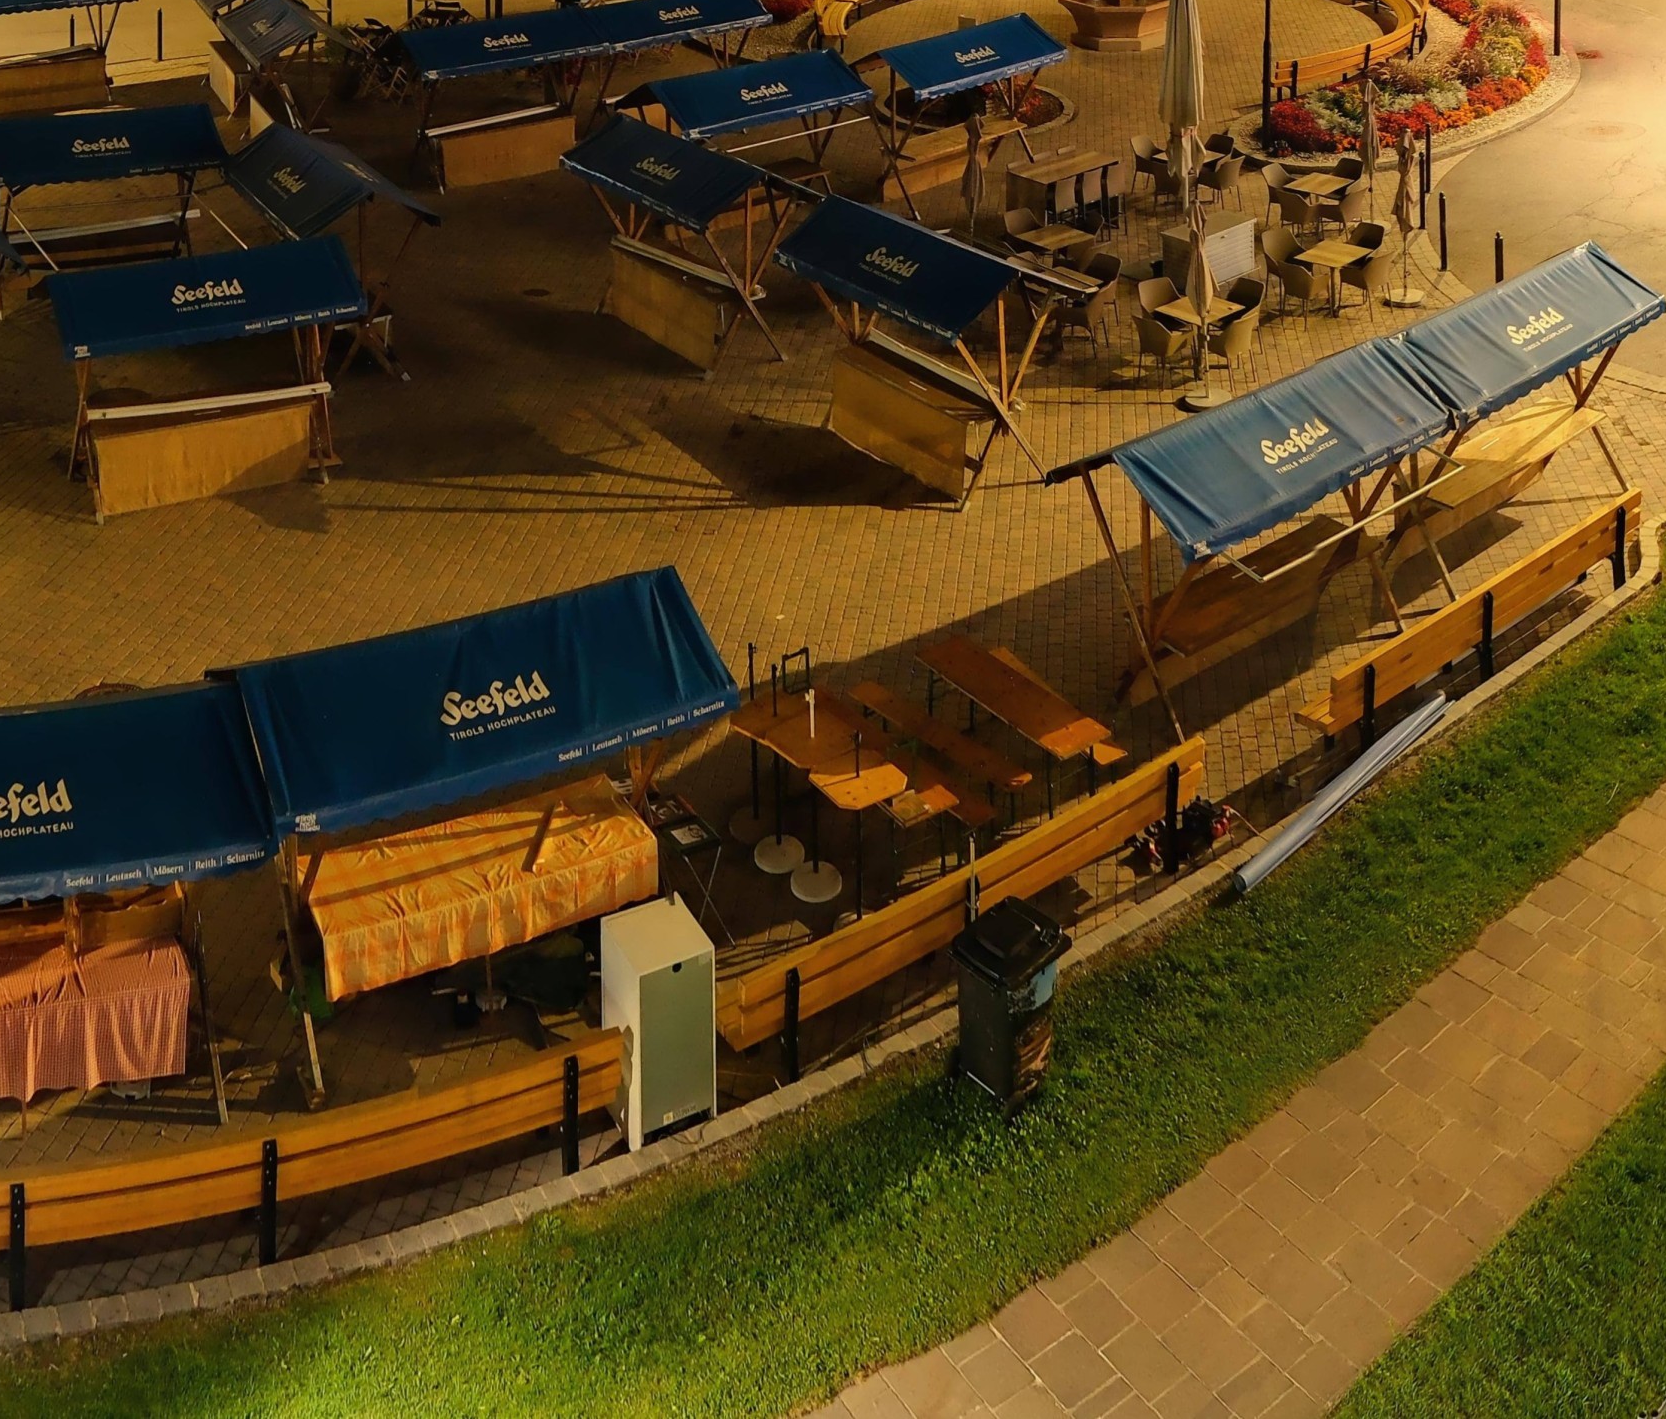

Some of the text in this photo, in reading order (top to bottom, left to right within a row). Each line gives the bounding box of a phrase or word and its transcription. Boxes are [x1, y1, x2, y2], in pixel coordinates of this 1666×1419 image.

[659, 6, 699, 21] Seefeld
[483, 33, 529, 49] Seefeld
[955, 45, 996, 63] Seefeld
[741, 82, 788, 100] Seefeld
[72, 136, 130, 153] Seefeld
[636, 157, 681, 181] Seefeld
[866, 247, 920, 278] Seefeld
[171, 279, 243, 305] Seefeld
[1507, 307, 1565, 345] Seefeld
[1261, 418, 1331, 465] Seefeld
[1275, 461, 1298, 476] TIROLS
[440, 670, 551, 726] Seefeld
[449, 706, 556, 742] TIROLS HOCHPLATEAU
[558, 700, 726, 763] Seefeld Leutasch Mösern Reith Scharnitz
[66, 849, 265, 888] Seefeld Leutasch Mösern Reith Scharnitz
